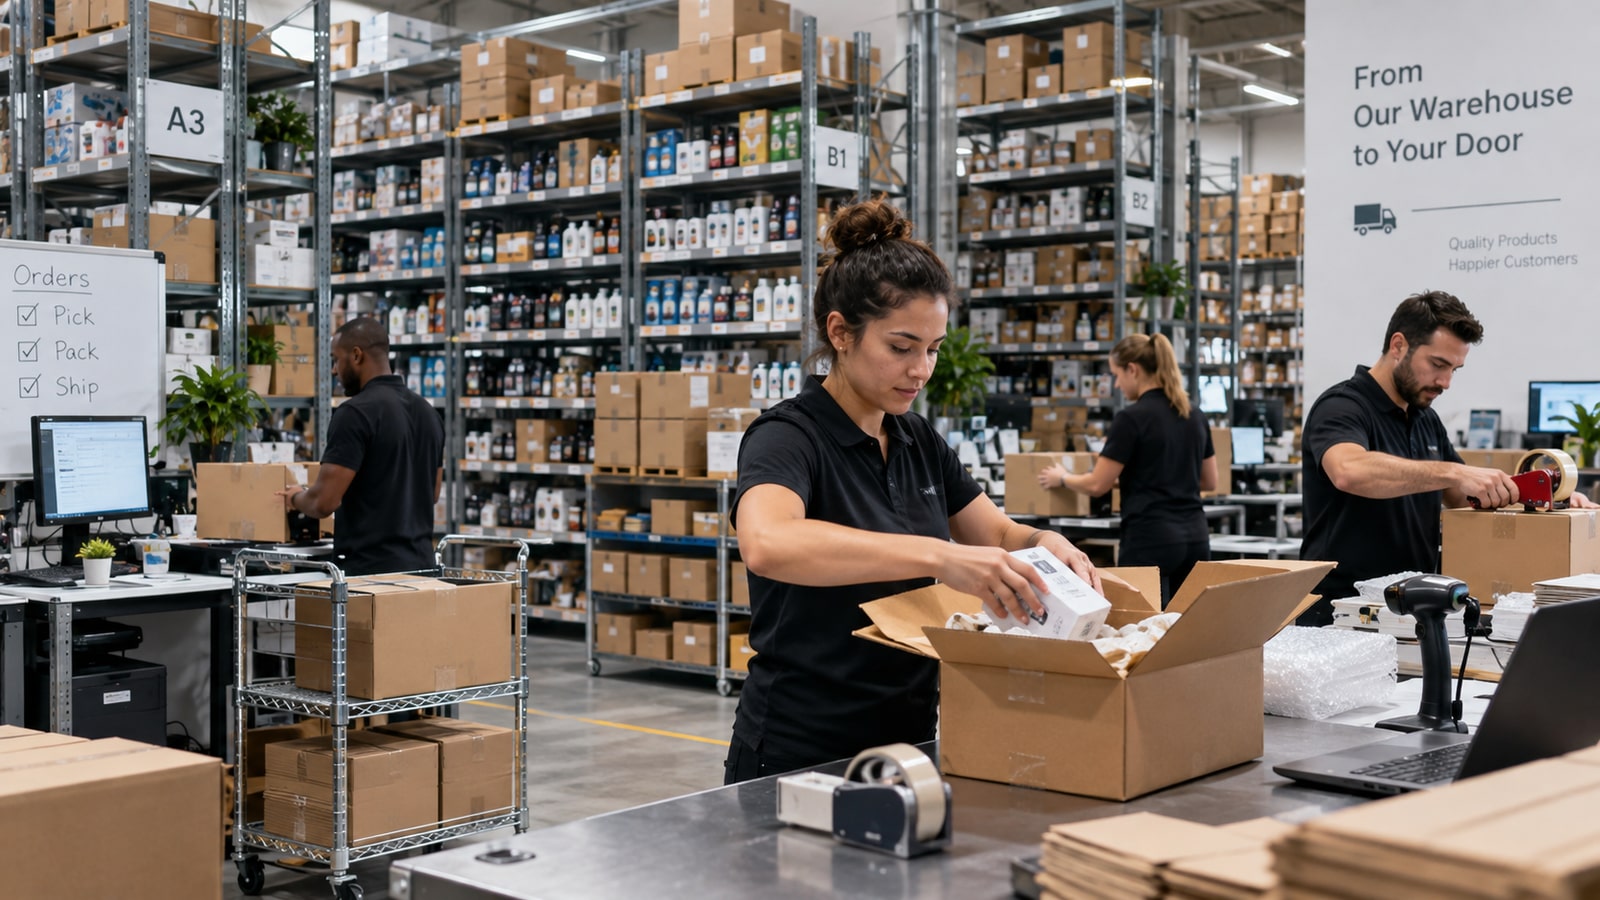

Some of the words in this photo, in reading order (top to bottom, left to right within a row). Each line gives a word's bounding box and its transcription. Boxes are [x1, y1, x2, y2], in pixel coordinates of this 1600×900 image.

[1355, 64, 1423, 90] From
[1354, 104, 1402, 128] Our
[1409, 86, 1573, 121] Warehouse
[167, 106, 205, 136] A3
[828, 146, 847, 169] B1
[1353, 144, 1379, 167] to
[1387, 139, 1448, 163] Your
[1456, 132, 1524, 157] Door
[1133, 191, 1148, 211] B2
[1449, 236, 1494, 251] Quality
[1498, 233, 1558, 247] Products
[1449, 256, 1500, 272] Happier
[1504, 254, 1578, 269] Customers
[13, 264, 90, 288] Orders
[54, 304, 95, 326] Pick
[55, 339, 100, 361] Pack
[56, 376, 99, 403] Ship
